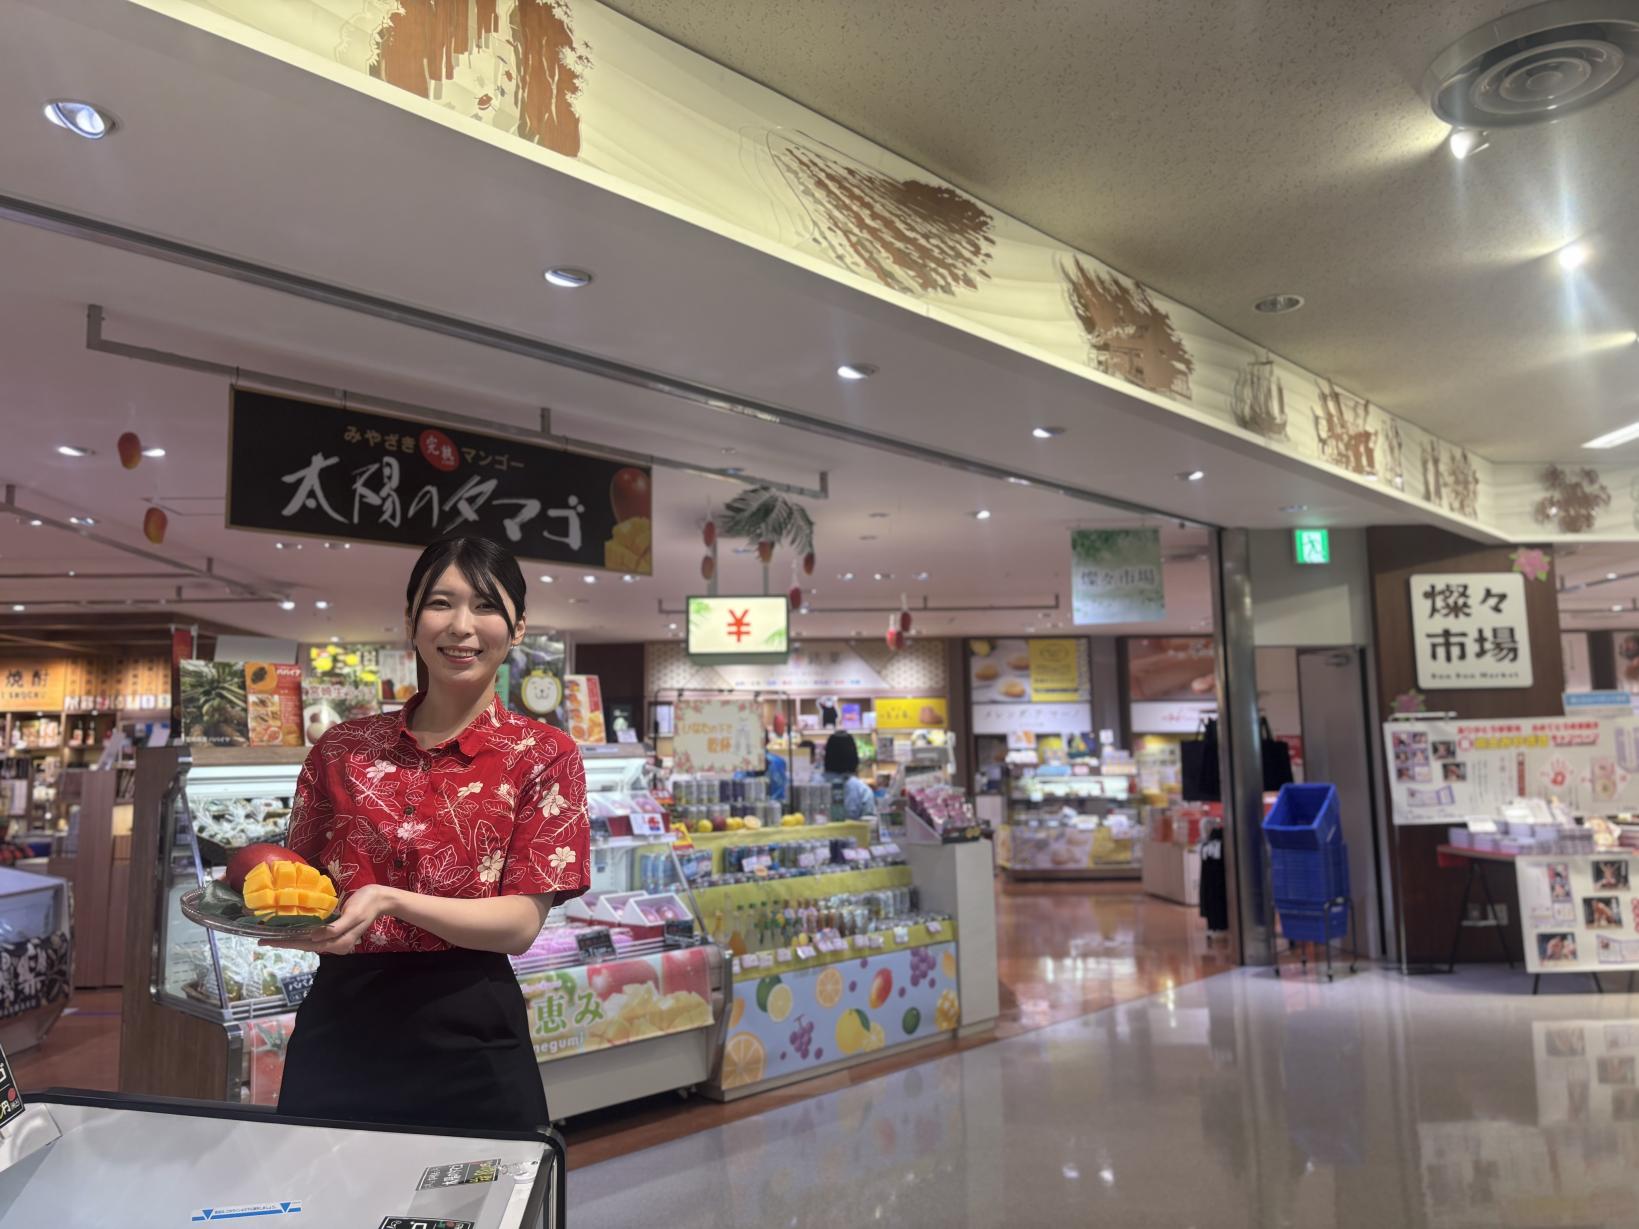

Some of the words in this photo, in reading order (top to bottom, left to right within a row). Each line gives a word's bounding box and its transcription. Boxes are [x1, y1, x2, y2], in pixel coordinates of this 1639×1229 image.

[344, 425, 417, 454] みやざき
[424, 434, 457, 467] 完熟
[461, 446, 526, 472] マンゴー
[281, 451, 586, 552] 太陽のタマゴ
[1423, 583, 1508, 619] 燦々
[1425, 626, 1519, 663] 市場
[1480, 671, 1519, 679] Market
[535, 991, 604, 1035] 恵み
